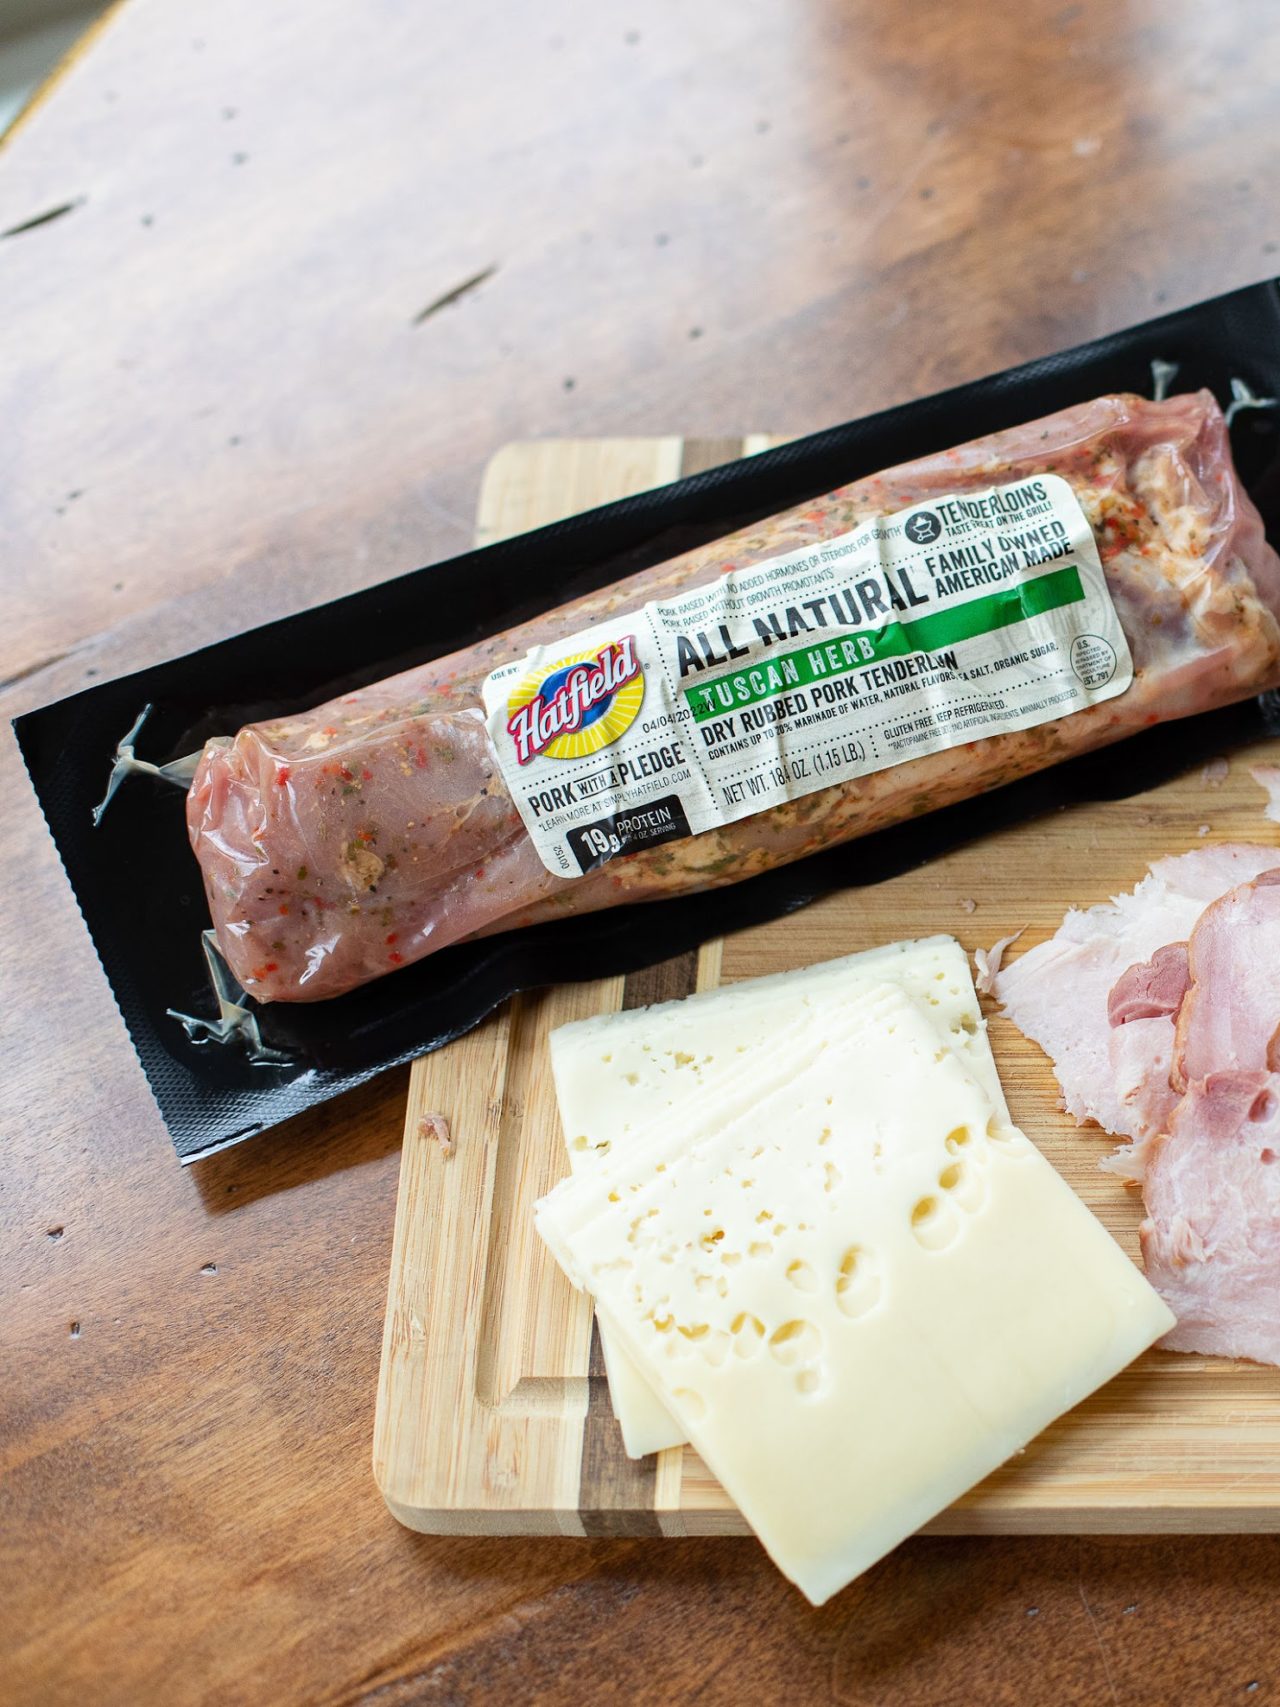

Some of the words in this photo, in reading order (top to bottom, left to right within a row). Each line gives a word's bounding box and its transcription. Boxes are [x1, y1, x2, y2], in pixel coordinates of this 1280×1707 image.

[936, 482, 1047, 526] TENDERLOINS
[945, 522, 972, 537] TASTE
[996, 516, 1009, 526] ON
[1009, 513, 1026, 524] THE
[1026, 501, 1053, 517] GRILL!
[925, 538, 995, 577] FAMILY
[997, 521, 1066, 551] OWNED
[936, 552, 1020, 598] AMERICAN
[1023, 537, 1074, 567] MADE
[678, 598, 704, 612] RAISED
[740, 574, 764, 592] ADDED
[765, 561, 809, 581] HORMONES
[809, 556, 820, 567] OR
[822, 544, 857, 562] STEROIDS
[857, 536, 872, 548] FOR
[677, 625, 750, 677] ALL
[753, 568, 929, 647] NATURAL
[683, 611, 709, 626] RAISED
[710, 599, 744, 614] WITHOUT
[746, 587, 782, 605] GROWTH
[491, 670, 507, 681] USE
[699, 658, 799, 711] TUSCAN
[807, 636, 876, 676] HERB
[1096, 671, 1109, 681] 791
[508, 635, 640, 764] Hatfield
[700, 717, 737, 747] DRY
[740, 693, 808, 733] RUBBED
[810, 676, 859, 708] PORK
[708, 738, 750, 760] CONTAINS
[750, 734, 762, 747] UP
[763, 728, 774, 740] TO
[794, 707, 837, 728] MARINADE
[839, 703, 850, 715] OF
[850, 694, 883, 711] WATER,
[883, 682, 920, 700] NATURAL
[969, 665, 994, 680] SALT,
[994, 652, 1029, 671] ORGANIC
[1031, 642, 1059, 659] SUGAR.
[884, 722, 914, 740] GLUTEN
[915, 716, 937, 731] FREE.
[954, 699, 1008, 718] REFRIGERATED.
[963, 716, 990, 731] ARTIFICIAL
[528, 782, 578, 817] PORK
[577, 776, 607, 796] WITH
[609, 770, 618, 786] A
[567, 806, 591, 821] MORE
[591, 802, 601, 813] AT
[604, 769, 692, 808] SIMPLYHATFIELD.COM
[722, 783, 746, 805] NET
[746, 774, 770, 797] WT.
[791, 759, 811, 780] OZ.
[813, 751, 841, 776] (1.15
[842, 741, 866, 764] LB.)
[617, 807, 671, 836] PROTEIN
[650, 823, 677, 836] SERVING
